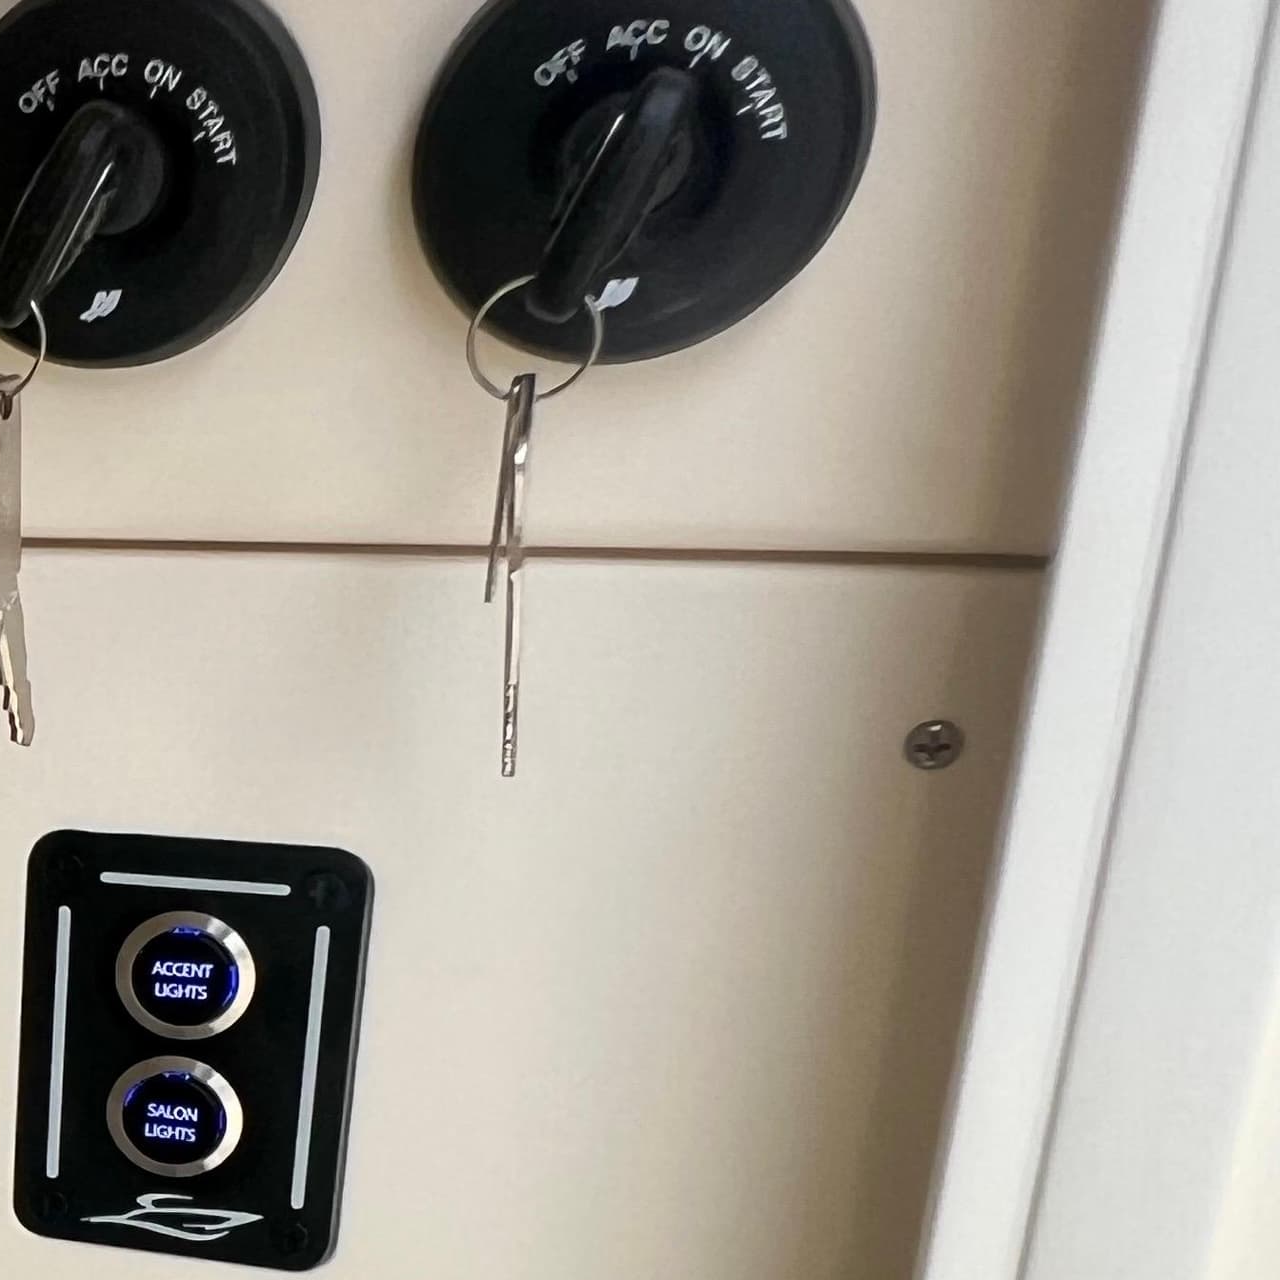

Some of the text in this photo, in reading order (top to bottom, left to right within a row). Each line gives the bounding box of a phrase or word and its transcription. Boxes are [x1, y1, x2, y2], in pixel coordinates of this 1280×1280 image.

[534, 39, 586, 86] OFF
[606, 19, 670, 51] ACC
[684, 25, 732, 61] ON
[18, 53, 237, 165] OFF ACC ON START
[151, 960, 214, 980] ACCENT
[154, 982, 208, 1000] LIGHTS
[146, 1103, 199, 1123] SALON
[144, 1122, 196, 1142] LIGHTS
